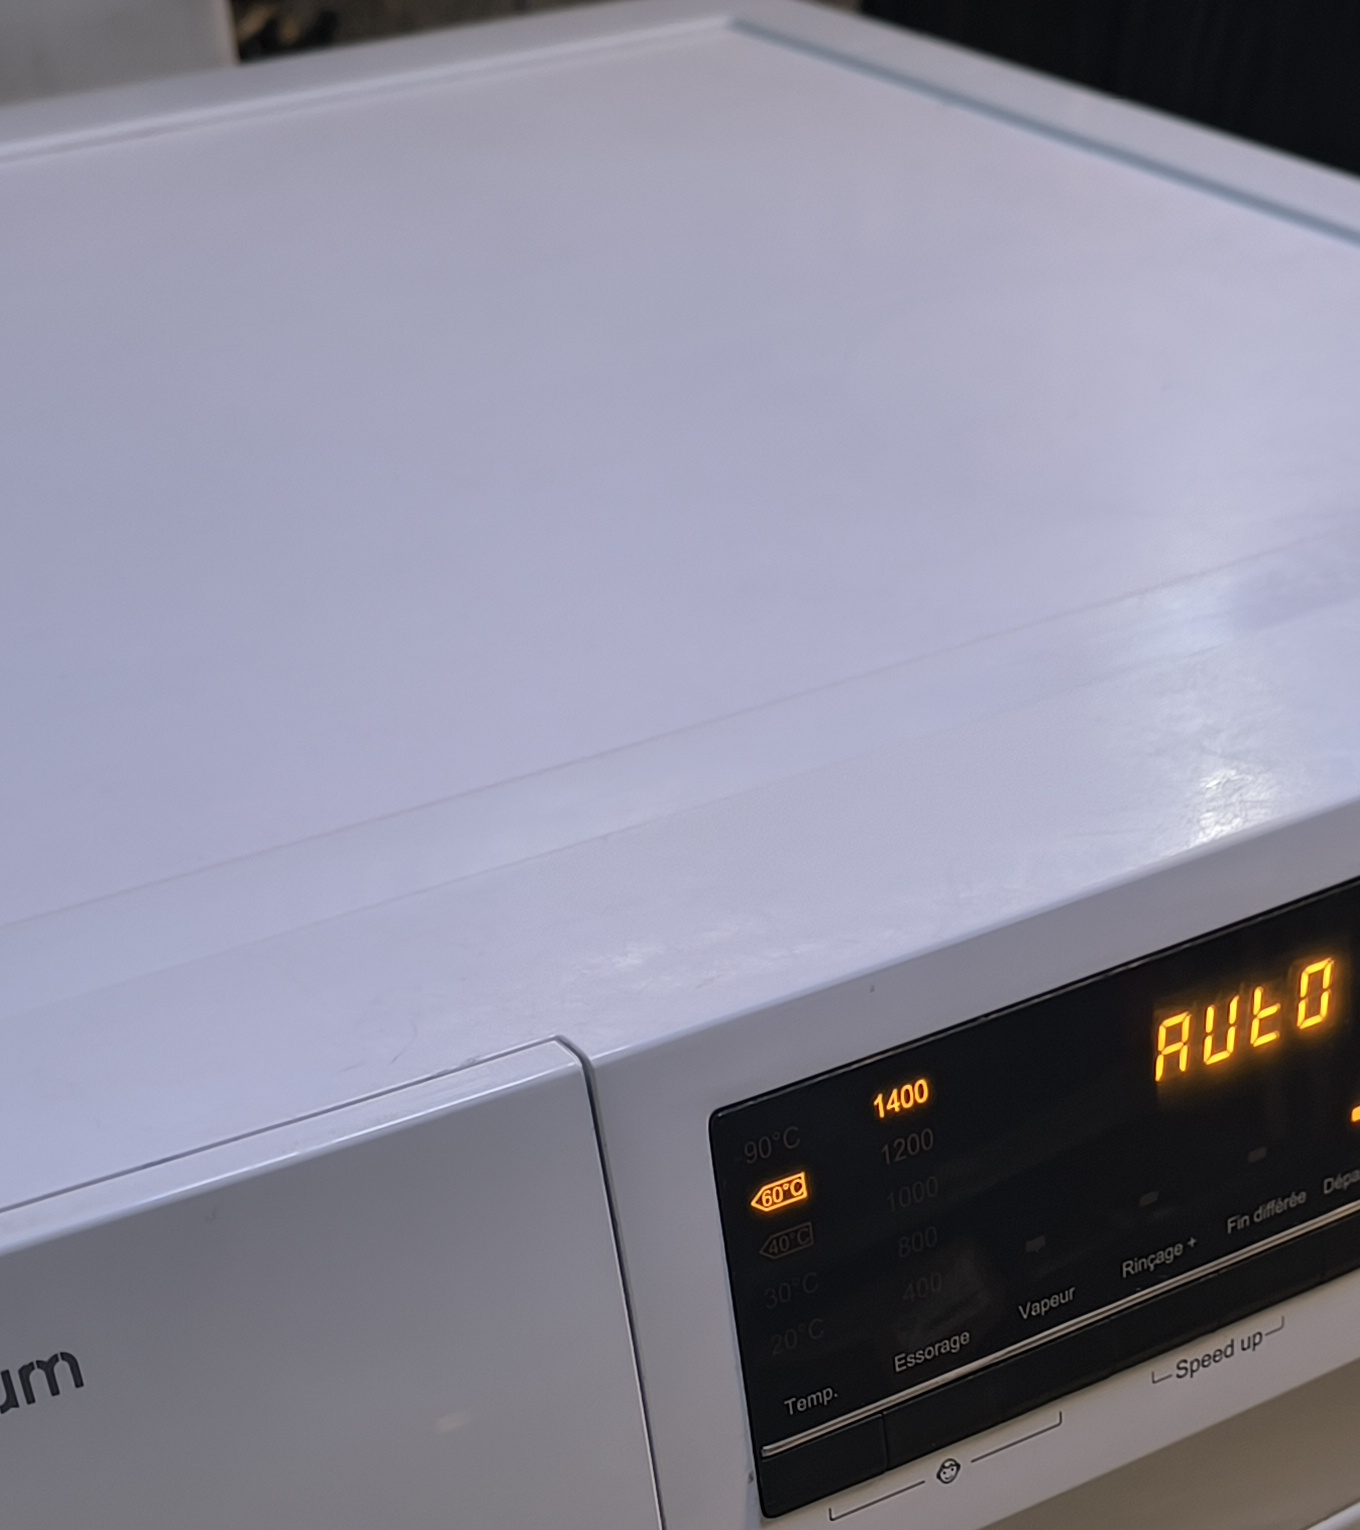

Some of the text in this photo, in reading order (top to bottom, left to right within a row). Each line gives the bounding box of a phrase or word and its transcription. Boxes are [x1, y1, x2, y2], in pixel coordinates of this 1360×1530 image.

[873, 1078, 929, 1118] 1400
[744, 1126, 801, 1164] 90°C
[881, 1128, 934, 1164] 1200
[762, 1177, 804, 1208] 60°C
[889, 1176, 938, 1211] 1000
[1227, 1191, 1308, 1235] Fin différée
[769, 1228, 809, 1256] 40°C
[898, 1226, 937, 1257] 800
[1122, 1245, 1183, 1280] Rinçage
[1018, 1286, 1076, 1322] Vapeur
[893, 1330, 970, 1374] Essorage
[1175, 1331, 1264, 1380] Speed up
[784, 1386, 838, 1417] Temp.
